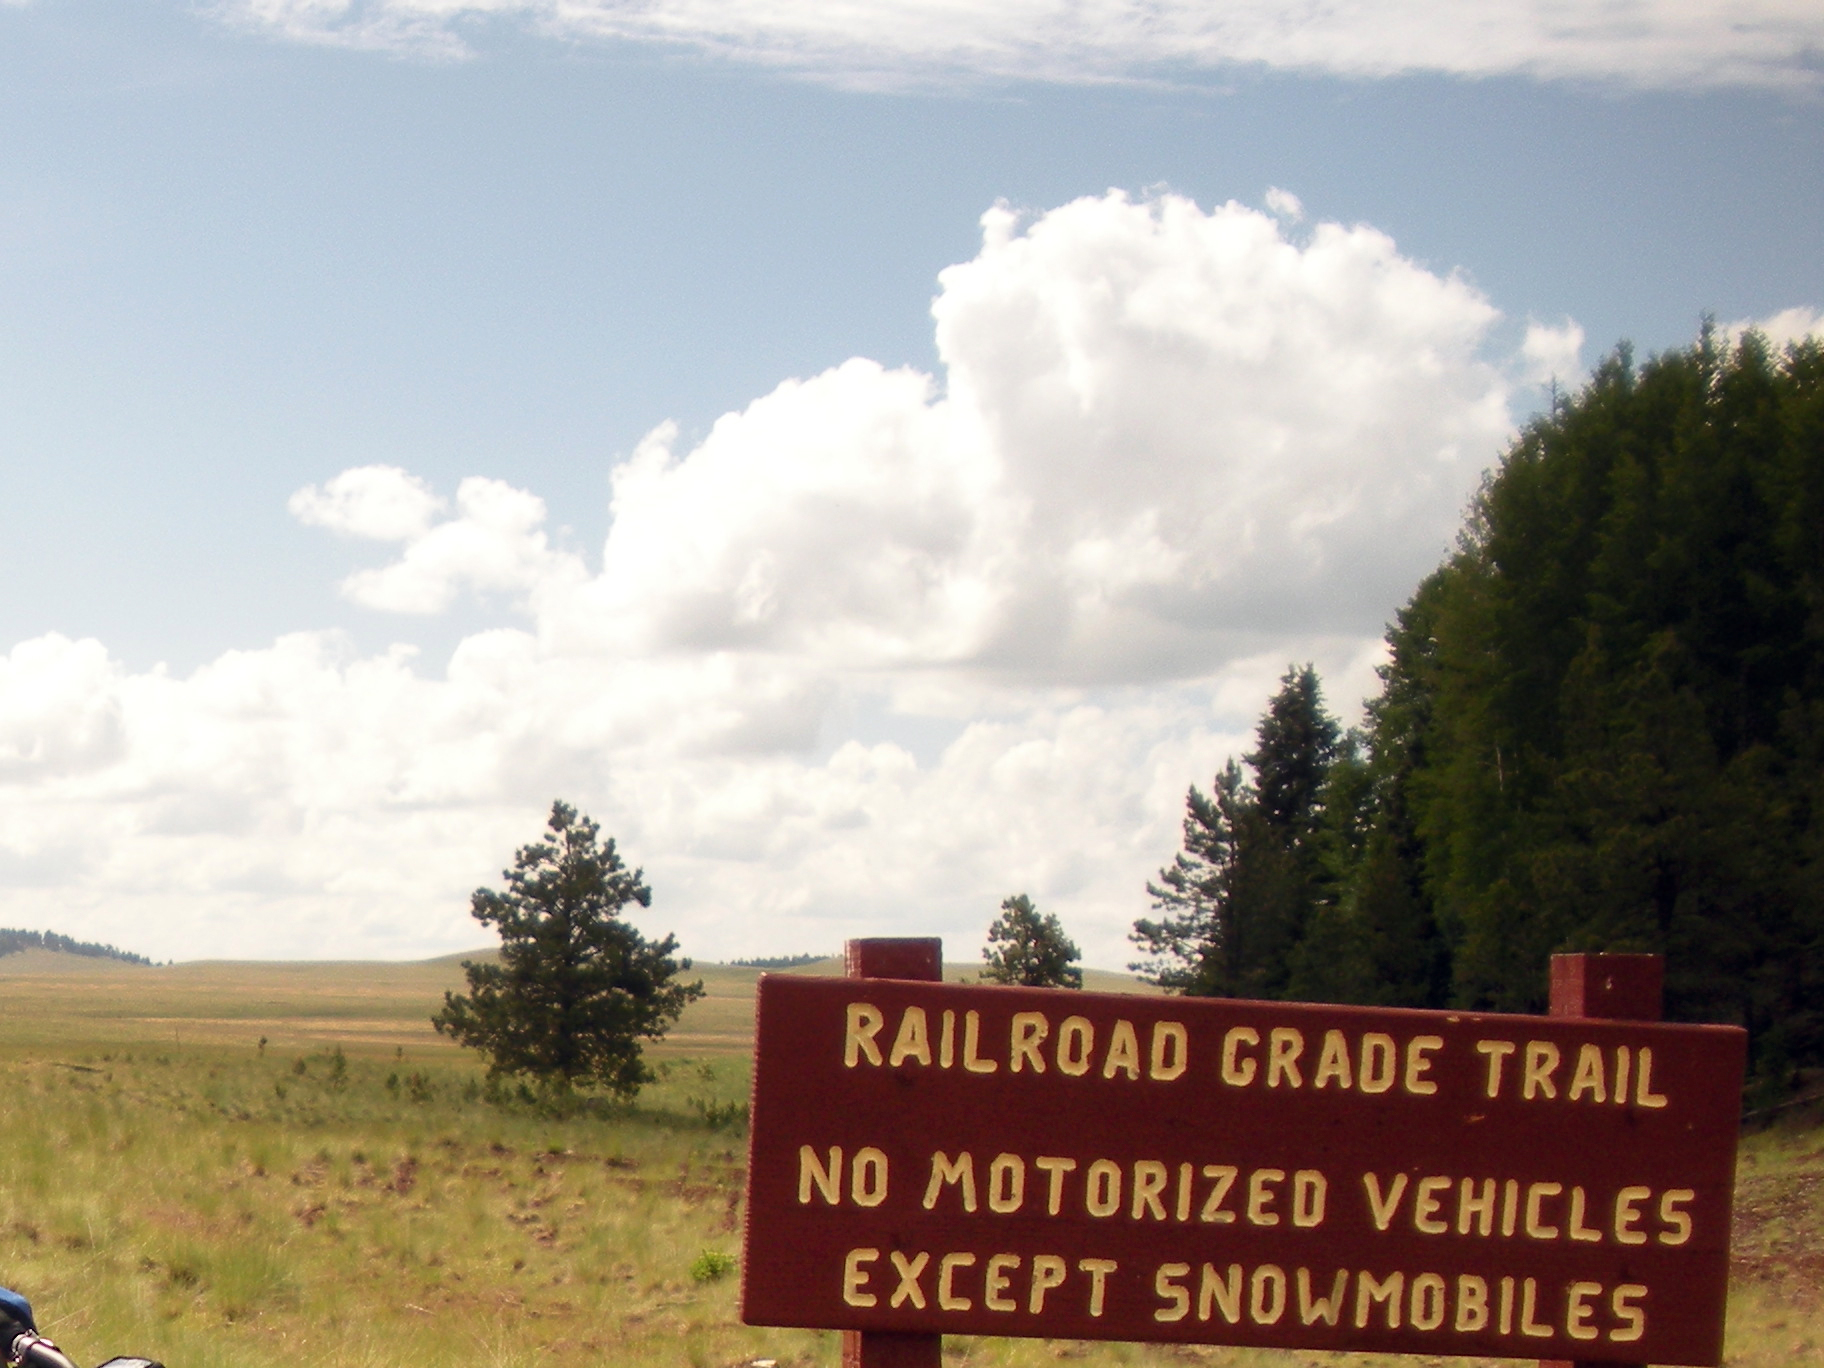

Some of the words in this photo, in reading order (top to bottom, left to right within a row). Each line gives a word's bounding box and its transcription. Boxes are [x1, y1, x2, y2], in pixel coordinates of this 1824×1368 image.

[844, 1003, 1188, 1081] RAILROAD
[1221, 1026, 1444, 1095] GRADE
[1476, 1040, 1668, 1109] TRAIL
[798, 1145, 889, 1207] NO
[922, 1151, 1328, 1228] MOTORIZED
[1362, 1172, 1695, 1246] VEHICLES
[843, 1248, 1118, 1317] EXCEPT
[1153, 1262, 1648, 1342] SNOWMOBILES
